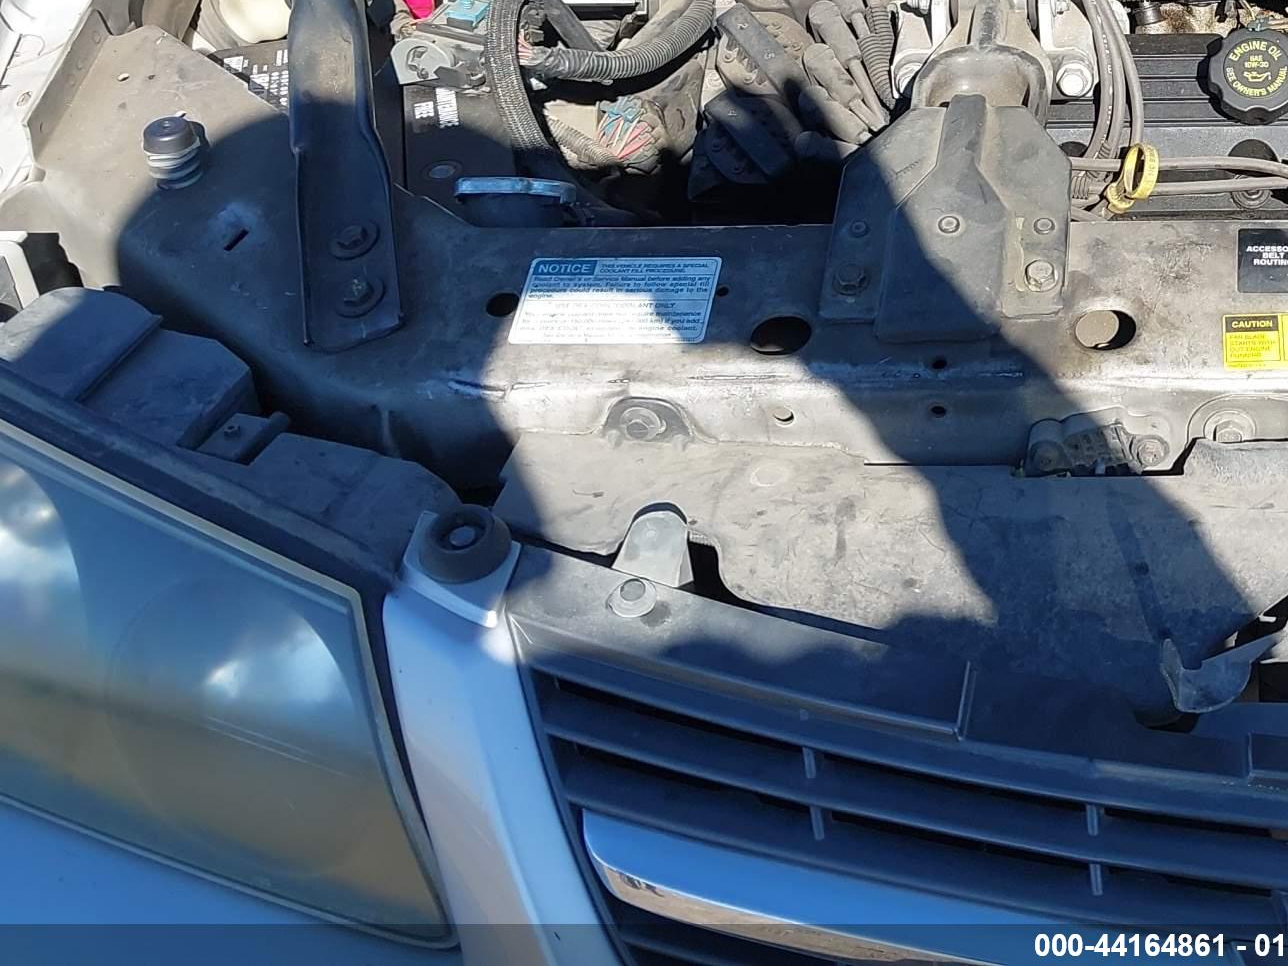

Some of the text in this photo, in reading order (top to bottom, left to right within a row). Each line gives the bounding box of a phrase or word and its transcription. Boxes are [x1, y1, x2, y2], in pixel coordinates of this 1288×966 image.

[1228, 40, 1282, 61] ENGINE OIL
[1266, 66, 1288, 93] MANUAL
[538, 263, 592, 273] NOTICE
[1231, 320, 1273, 329] CAUTION
